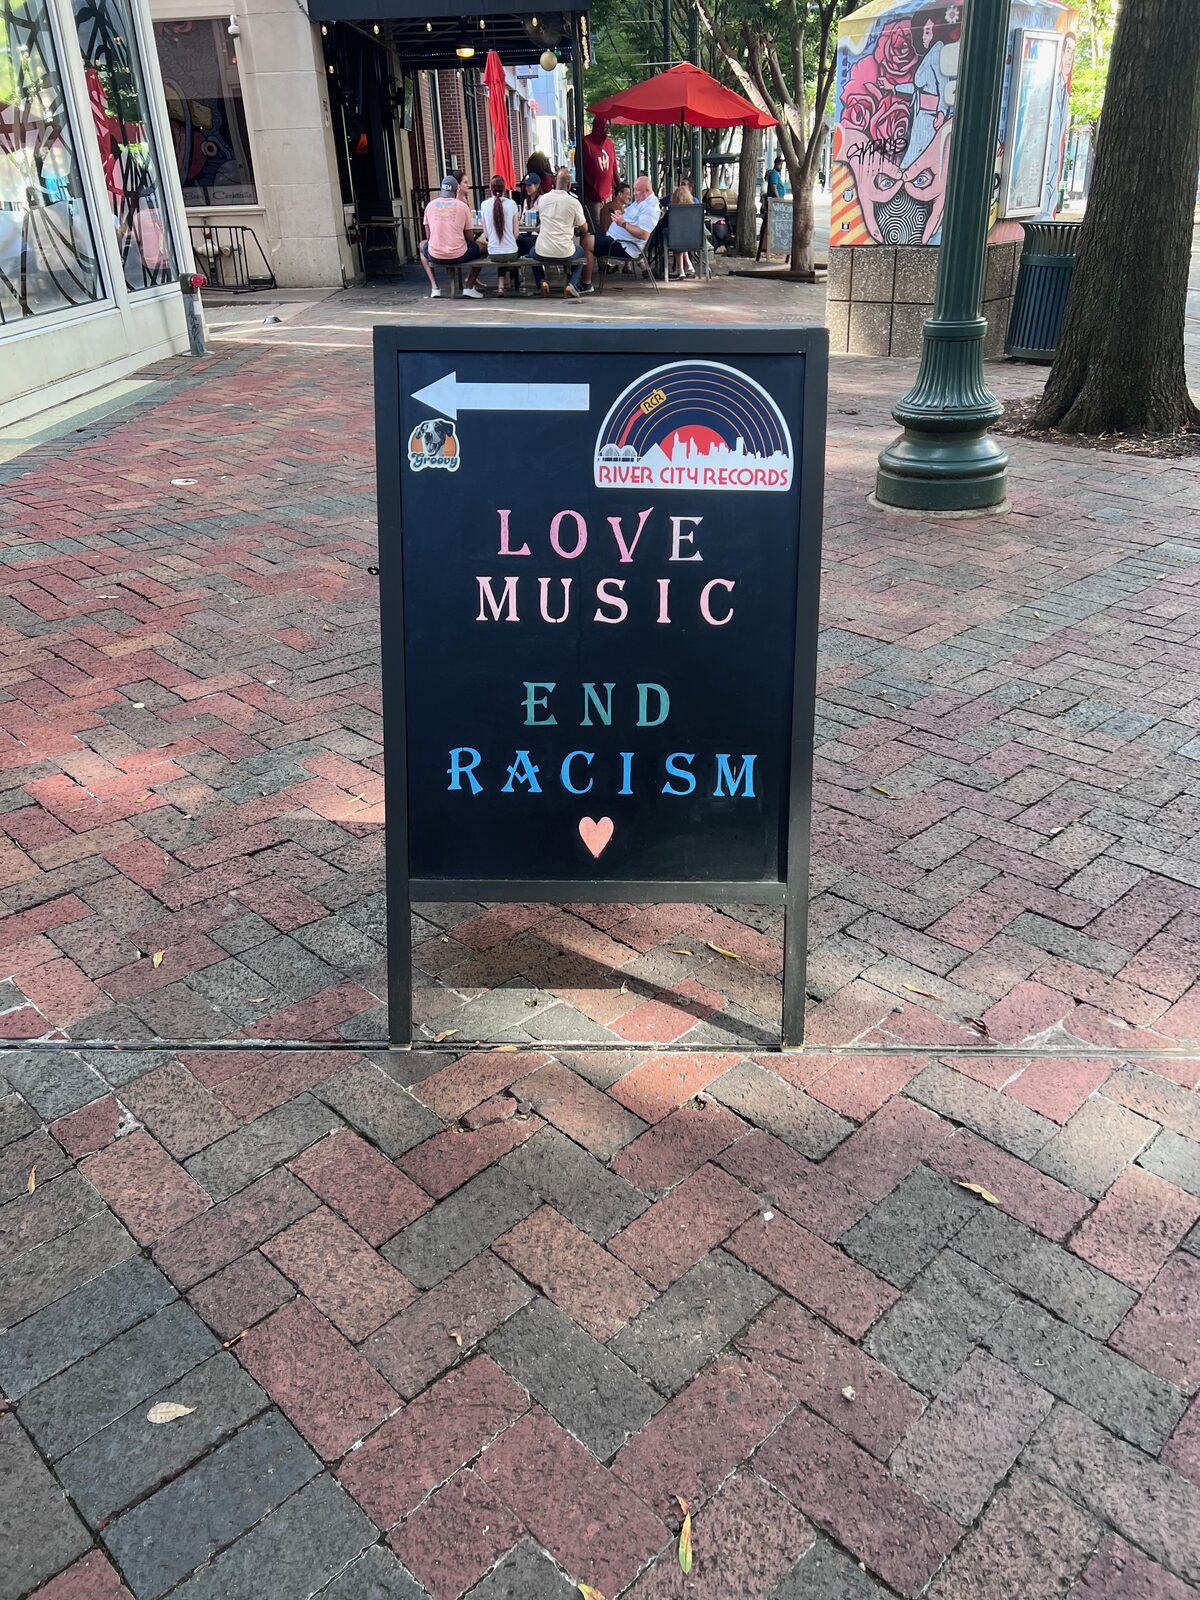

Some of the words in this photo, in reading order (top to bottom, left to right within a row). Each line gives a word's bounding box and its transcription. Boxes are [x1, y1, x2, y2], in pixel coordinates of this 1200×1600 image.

[643, 393, 664, 413] RCR
[411, 453, 458, 468] Groovy
[599, 465, 653, 484] RIVER
[659, 467, 698, 484] CITY
[703, 467, 788, 487] RECORDS
[497, 506, 704, 563] LOVE
[475, 575, 736, 626] MUSIC
[520, 681, 670, 727] END
[446, 746, 758, 798] RACISM
